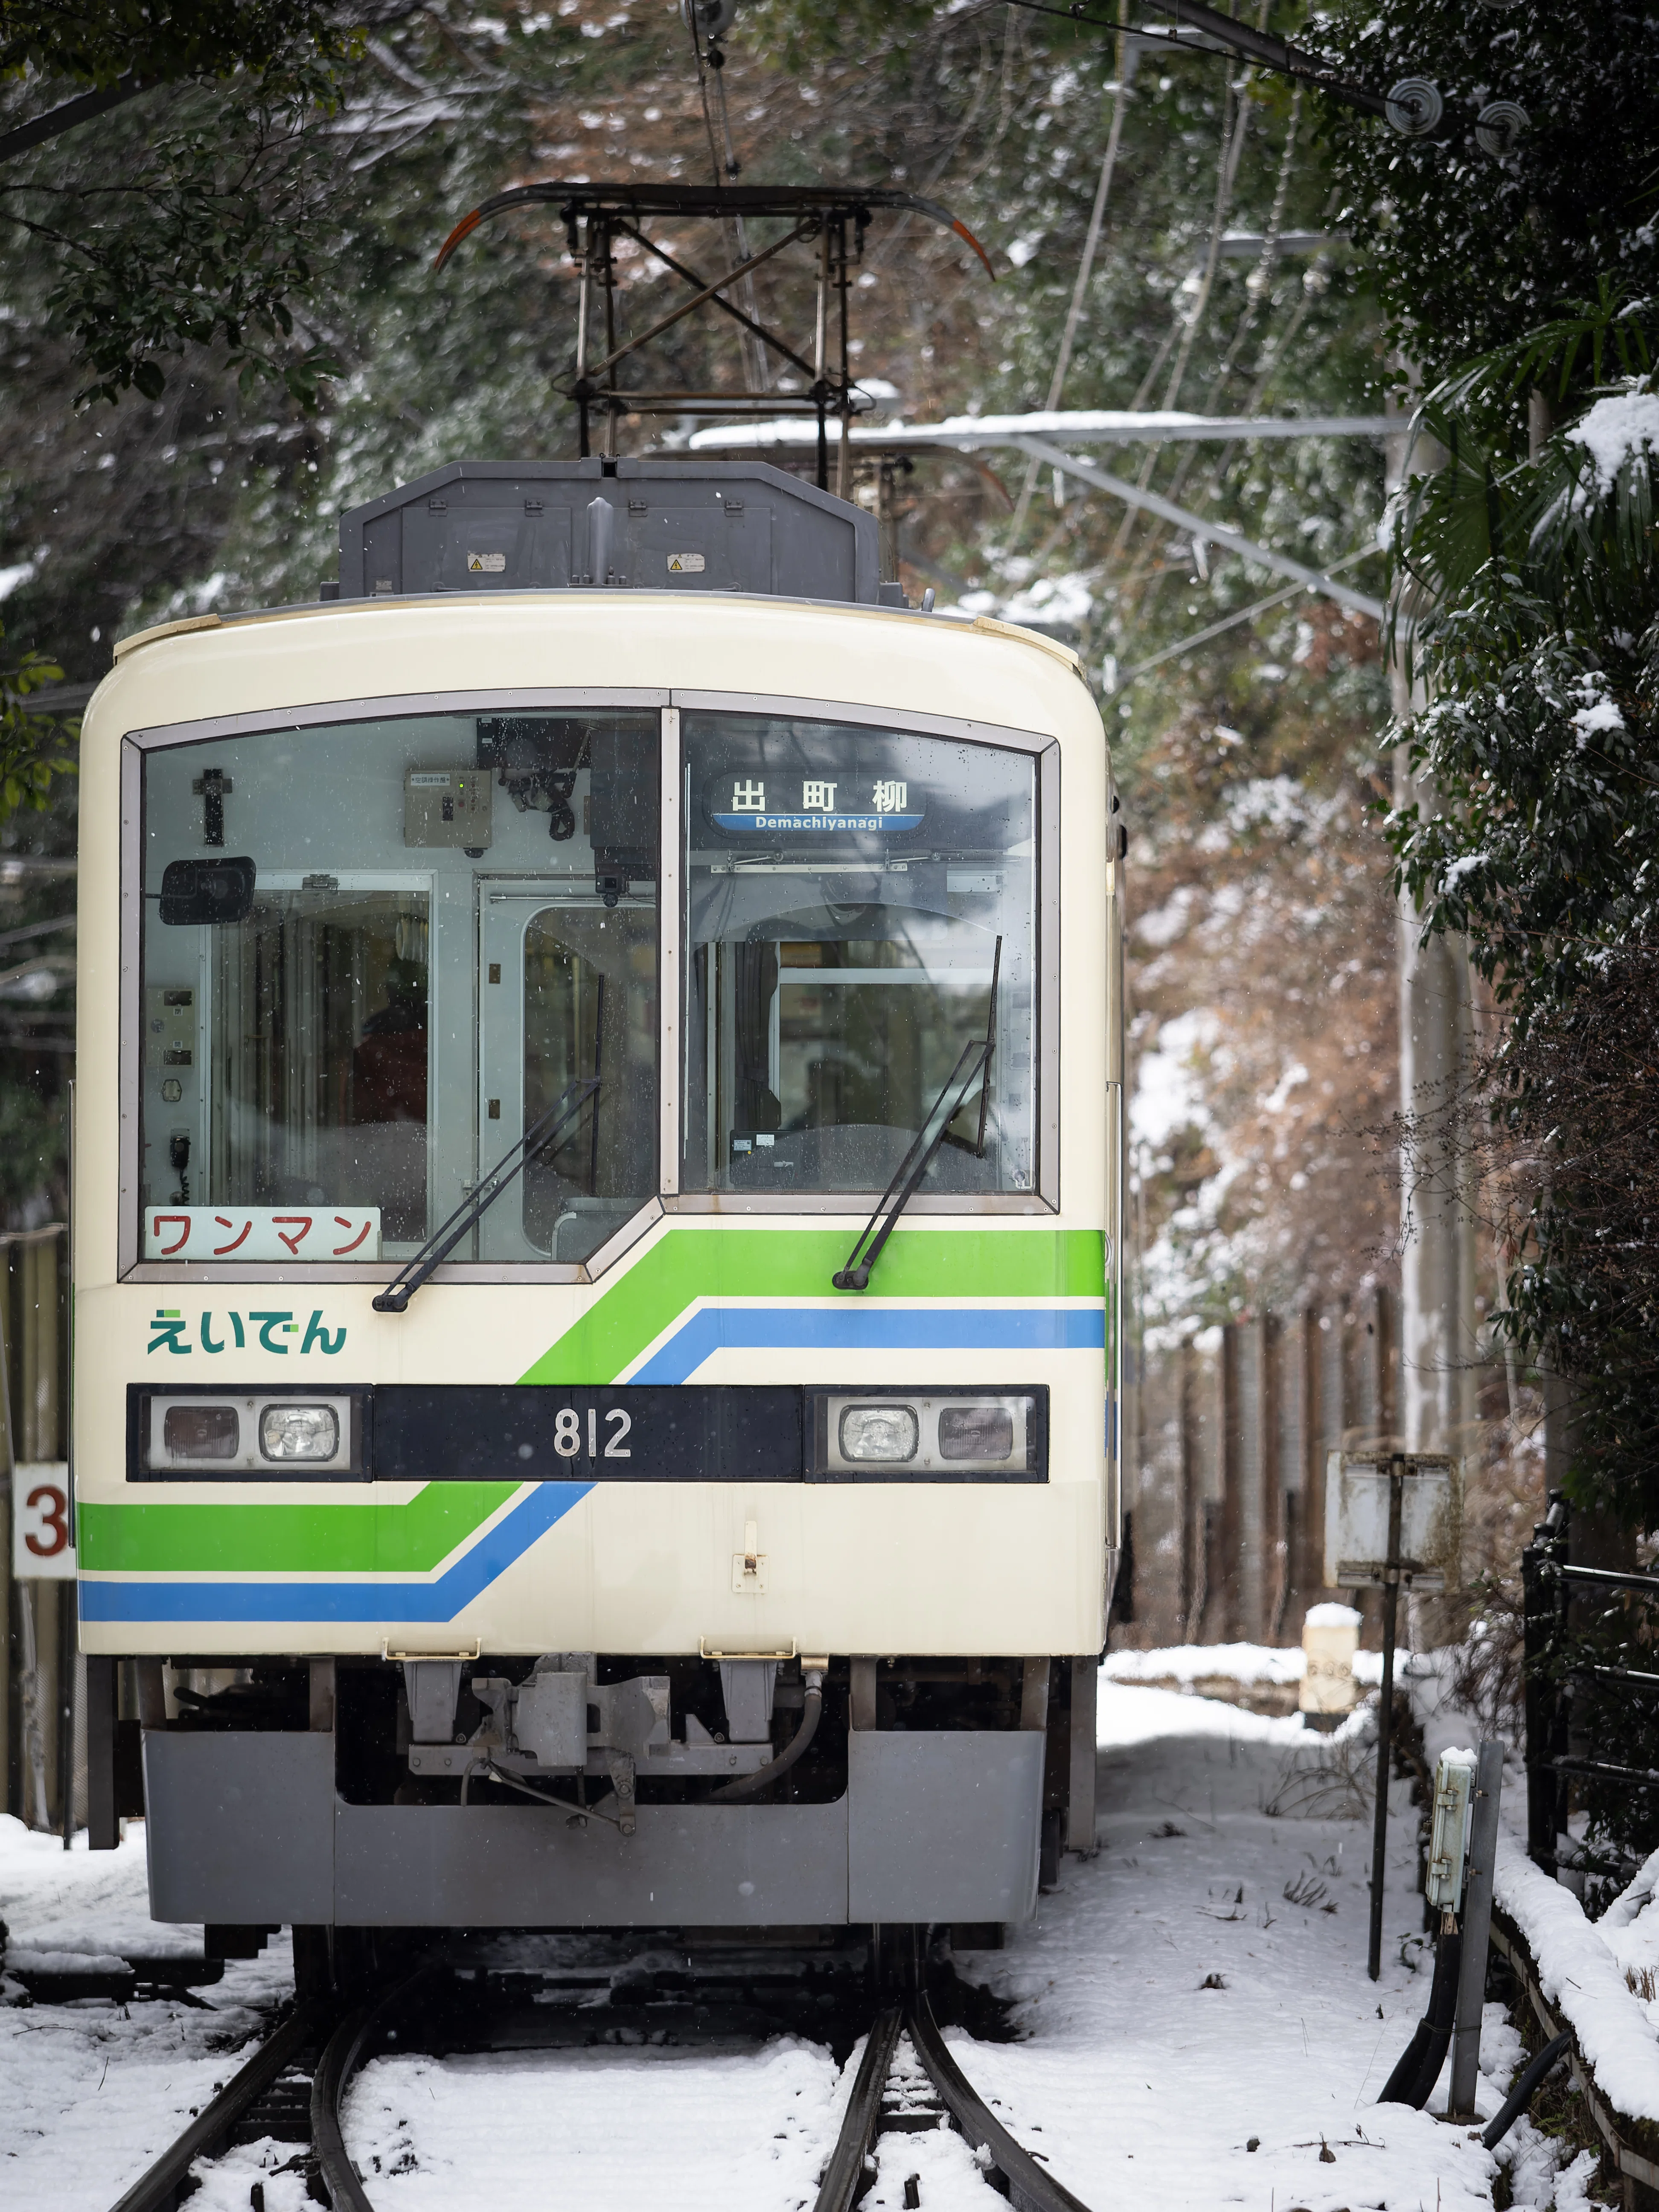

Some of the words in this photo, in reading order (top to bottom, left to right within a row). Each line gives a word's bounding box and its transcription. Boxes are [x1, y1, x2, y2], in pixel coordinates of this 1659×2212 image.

[732, 779, 907, 812] 出町柳
[756, 816, 883, 831] Demachiyanagi
[154, 1216, 371, 1255] ワンマン
[148, 1310, 347, 1355] えいでん
[554, 1408, 632, 1457] 812
[26, 1484, 68, 1557] 3
